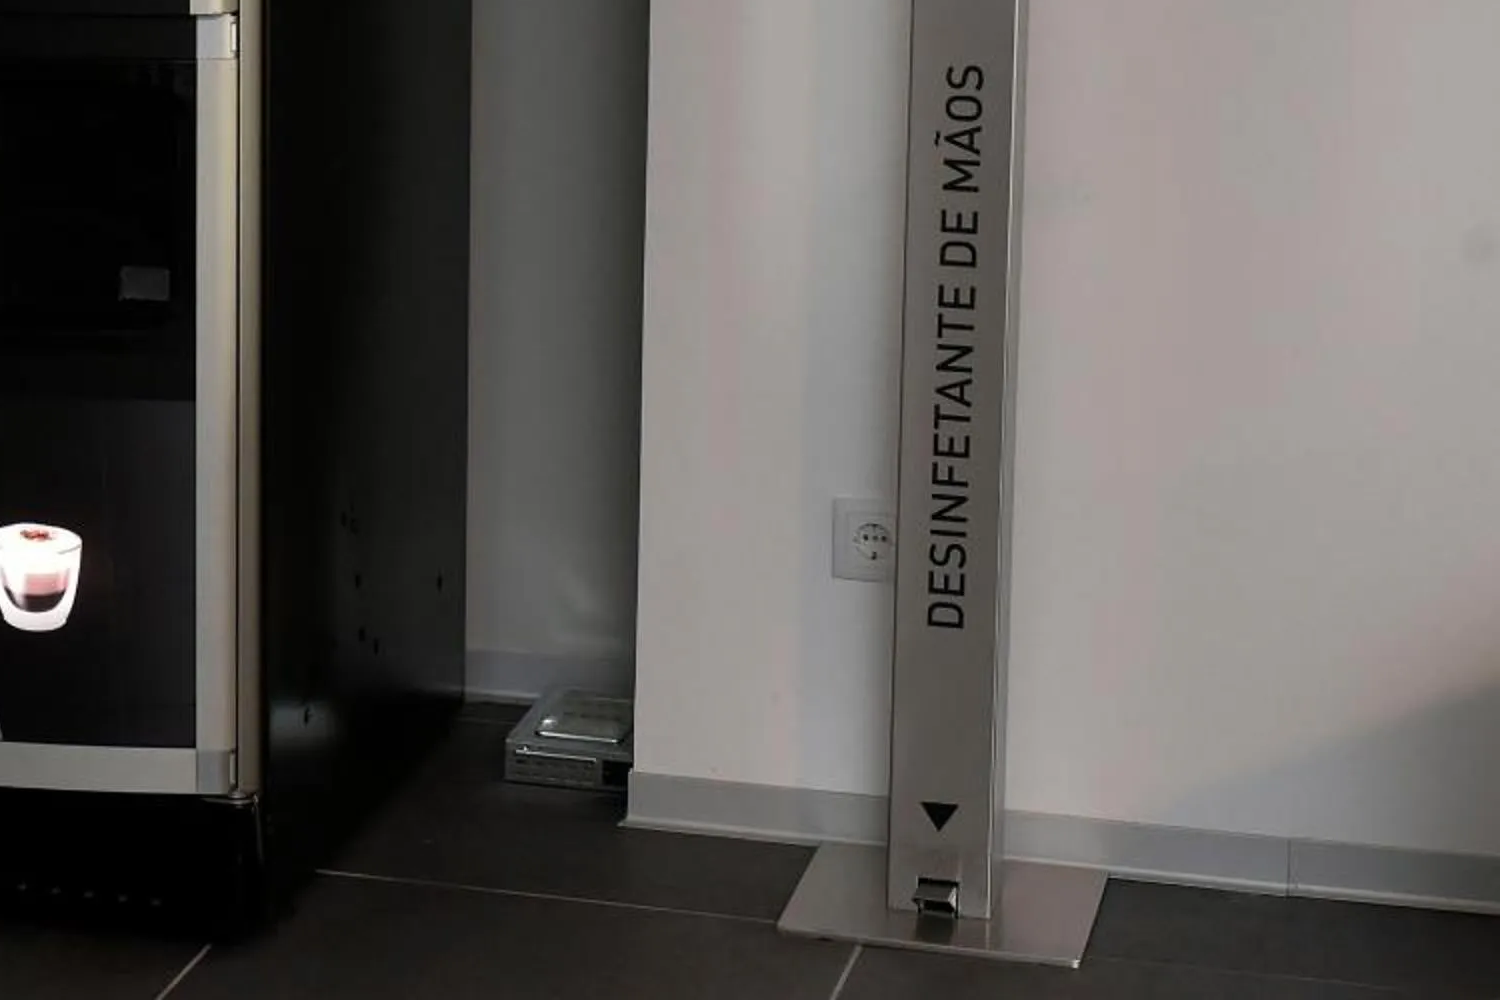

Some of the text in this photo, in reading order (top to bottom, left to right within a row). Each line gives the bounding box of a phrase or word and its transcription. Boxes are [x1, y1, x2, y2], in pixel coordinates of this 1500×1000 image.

[928, 65, 984, 629] DESINFETANTE DE MÃOS
